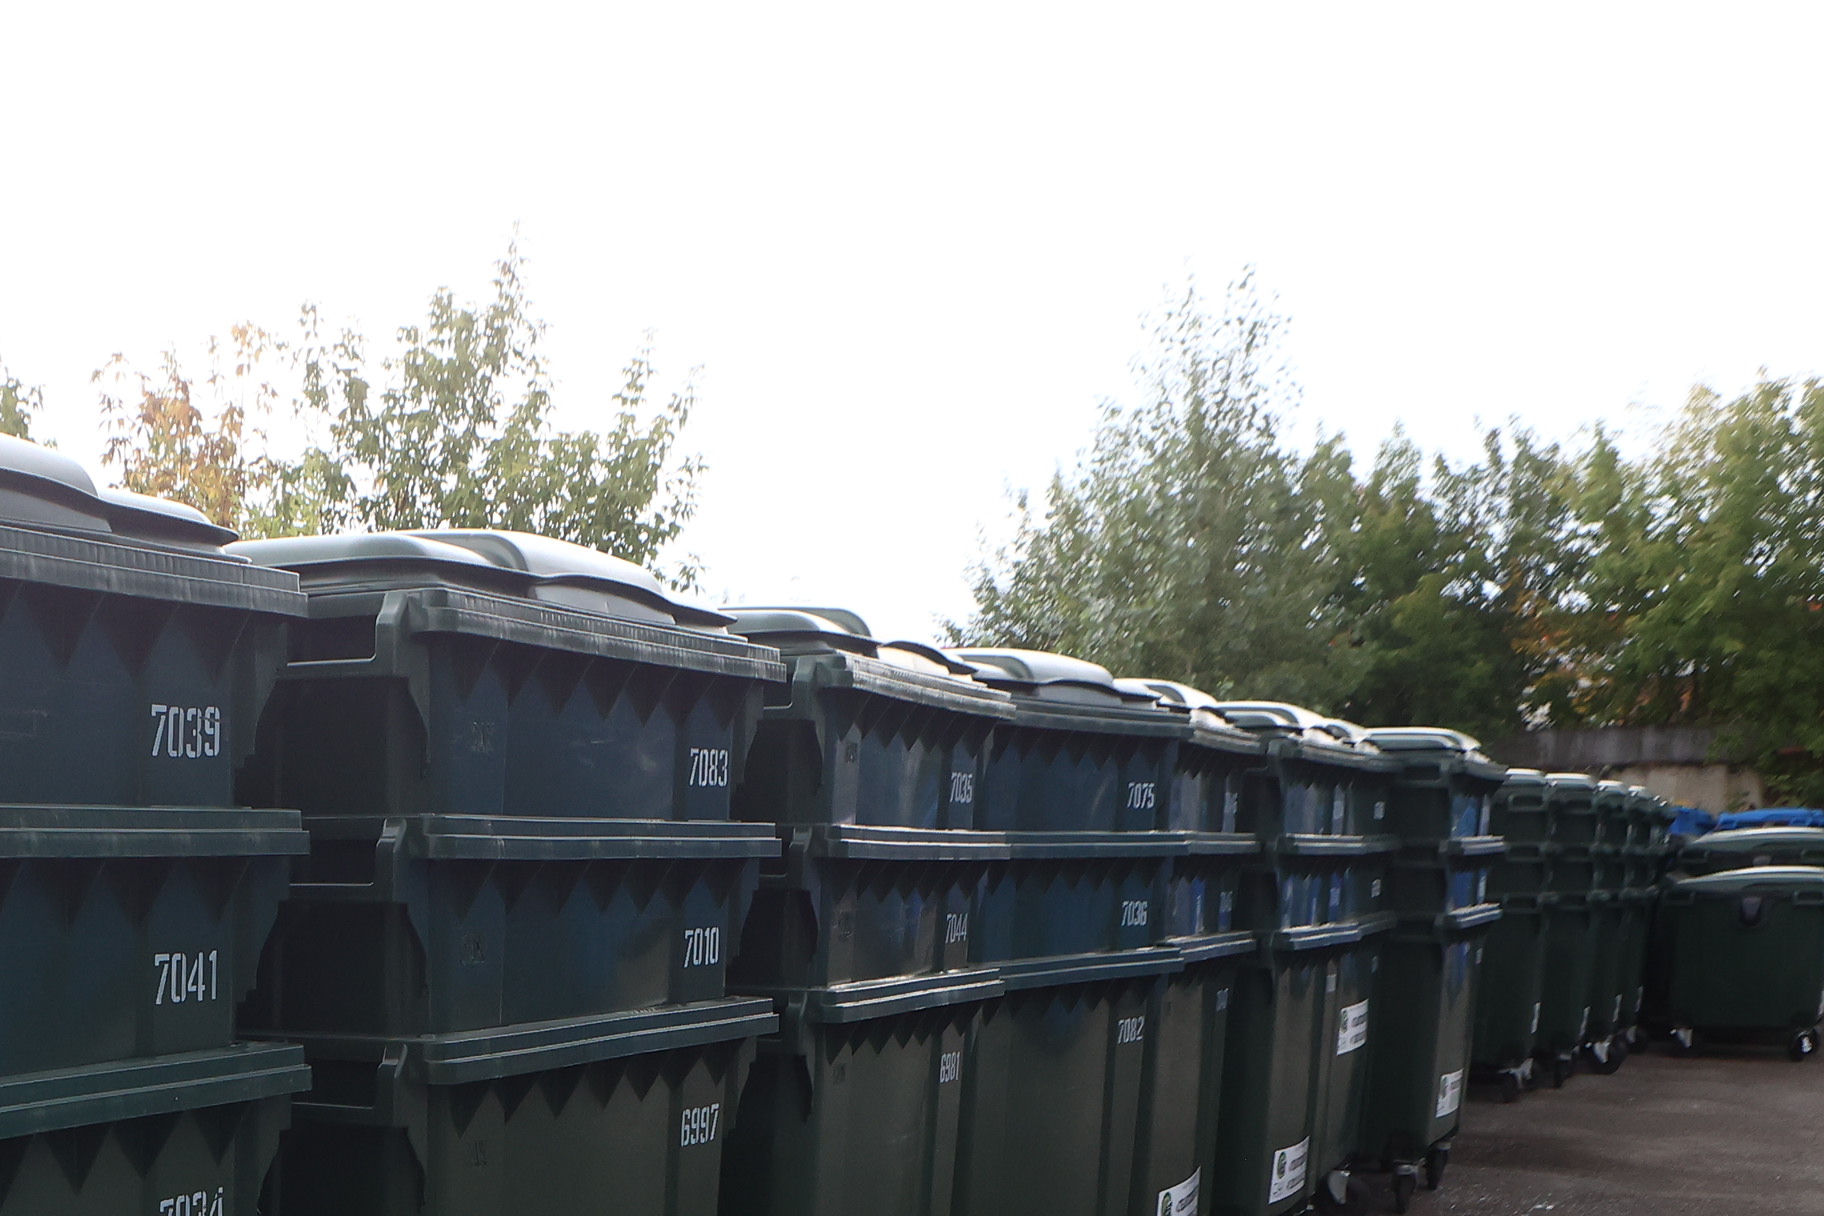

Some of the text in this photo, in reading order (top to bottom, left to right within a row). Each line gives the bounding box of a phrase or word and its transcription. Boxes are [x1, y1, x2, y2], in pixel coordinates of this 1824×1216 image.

[151, 704, 221, 758] 7039
[689, 748, 728, 787] 7083
[950, 772, 973, 804] 7035
[1127, 782, 1155, 809] 7075
[945, 912, 969, 944] 7044
[1121, 901, 1148, 927] 7036
[684, 927, 720, 968] 7010
[154, 950, 217, 1005] 7041
[1117, 1015, 1145, 1044] 7082
[939, 1051, 961, 1084] 6981
[680, 1103, 719, 1147] 6997
